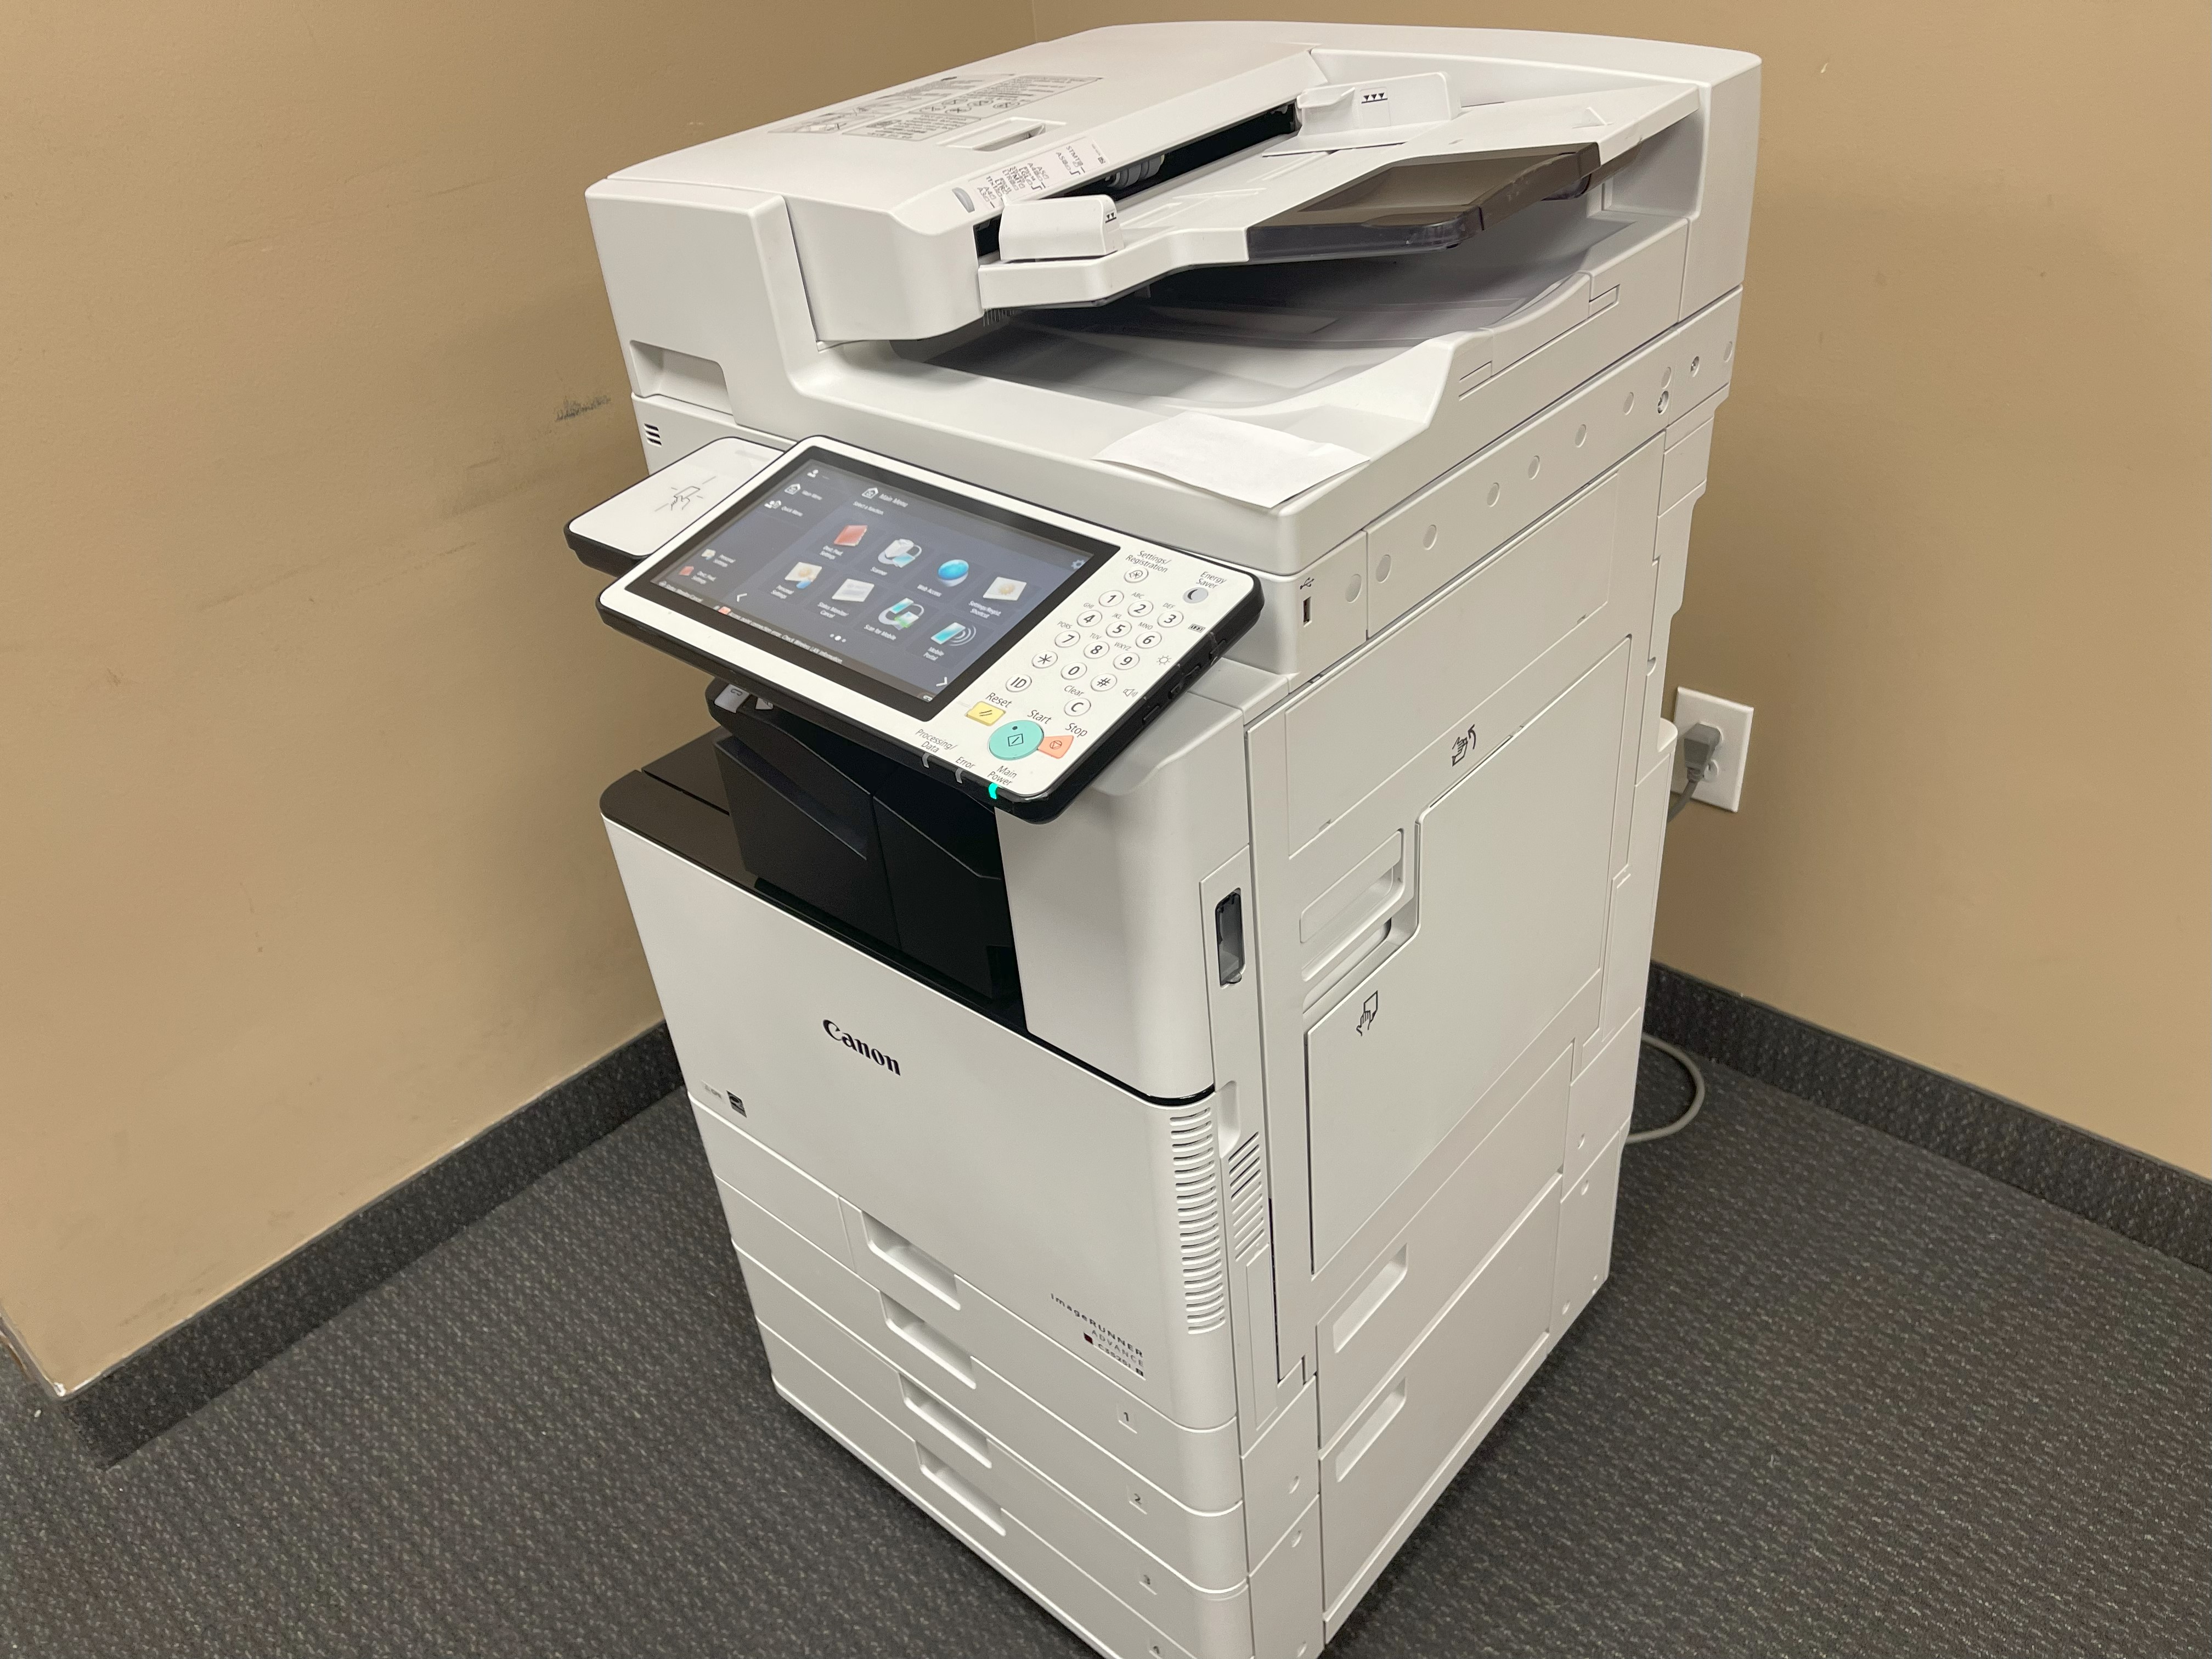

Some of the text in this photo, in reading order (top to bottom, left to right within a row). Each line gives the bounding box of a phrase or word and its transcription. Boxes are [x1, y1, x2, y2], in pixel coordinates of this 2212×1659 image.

[878, 493, 908, 507] Main Menu
[1137, 550, 1172, 565] Settings/
[1126, 555, 1168, 573] Registration
[1200, 571, 1227, 584] Energy
[1196, 578, 1218, 589] Saver
[1108, 595, 1116, 603] 1
[1133, 604, 1146, 613] 2
[1084, 614, 1096, 623] 4
[1164, 614, 1176, 623] 3
[1057, 620, 1073, 629] PQRS
[1112, 624, 1126, 633] 5
[881, 631, 896, 640] Mobile
[1062, 635, 1075, 643] 7
[1142, 635, 1155, 644] 6
[928, 646, 944, 656] Mobile
[1090, 645, 1103, 654] 8
[1114, 642, 1132, 651] WXYZ
[1120, 656, 1132, 665] 9
[1068, 666, 1080, 675] 0
[1011, 677, 1027, 688] ID
[1097, 678, 1111, 687] #
[1064, 685, 1084, 697] Clear
[985, 692, 1012, 708] Reset
[1071, 703, 1084, 712] C
[1027, 709, 1052, 724] Start
[1065, 723, 1087, 737] Stop
[915, 729, 958, 750] Processing/
[921, 742, 939, 753] Data
[955, 757, 975, 769] Error
[997, 765, 1017, 779] Main
[987, 771, 1013, 786] Power
[823, 1019, 900, 1076] Canon
[1051, 1293, 1143, 1358] imageRUNNER
[1092, 1330, 1143, 1367] ADVANCE
[1124, 1412, 1129, 1421] 1
